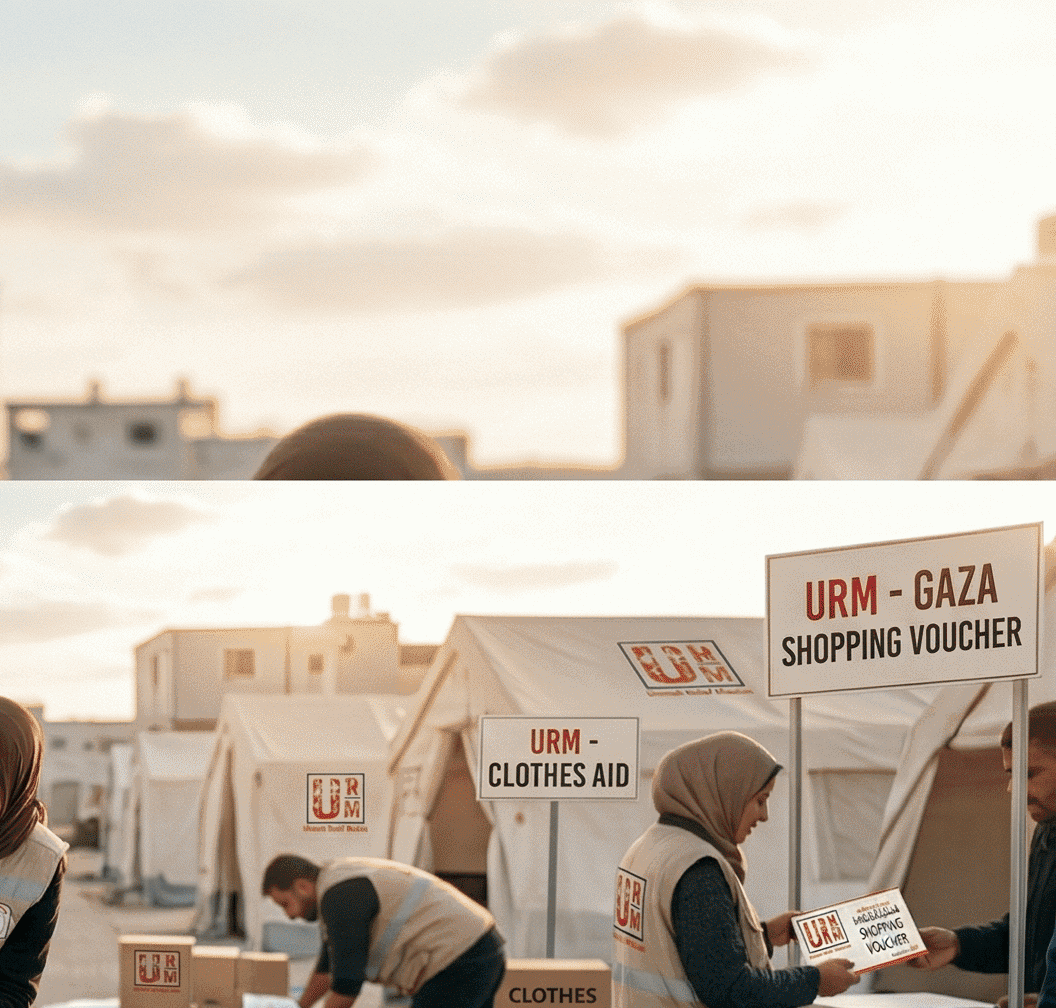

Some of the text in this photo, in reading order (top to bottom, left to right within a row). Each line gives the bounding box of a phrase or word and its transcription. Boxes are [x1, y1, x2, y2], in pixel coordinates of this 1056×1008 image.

[805, 574, 878, 622] URM
[913, 562, 999, 611] GAZA
[781, 616, 1022, 667] SHOPPING VOUCHER
[530, 728, 581, 755] URM
[488, 762, 630, 788] CLOTHES AID
[508, 987, 597, 1004] CLOTHES
